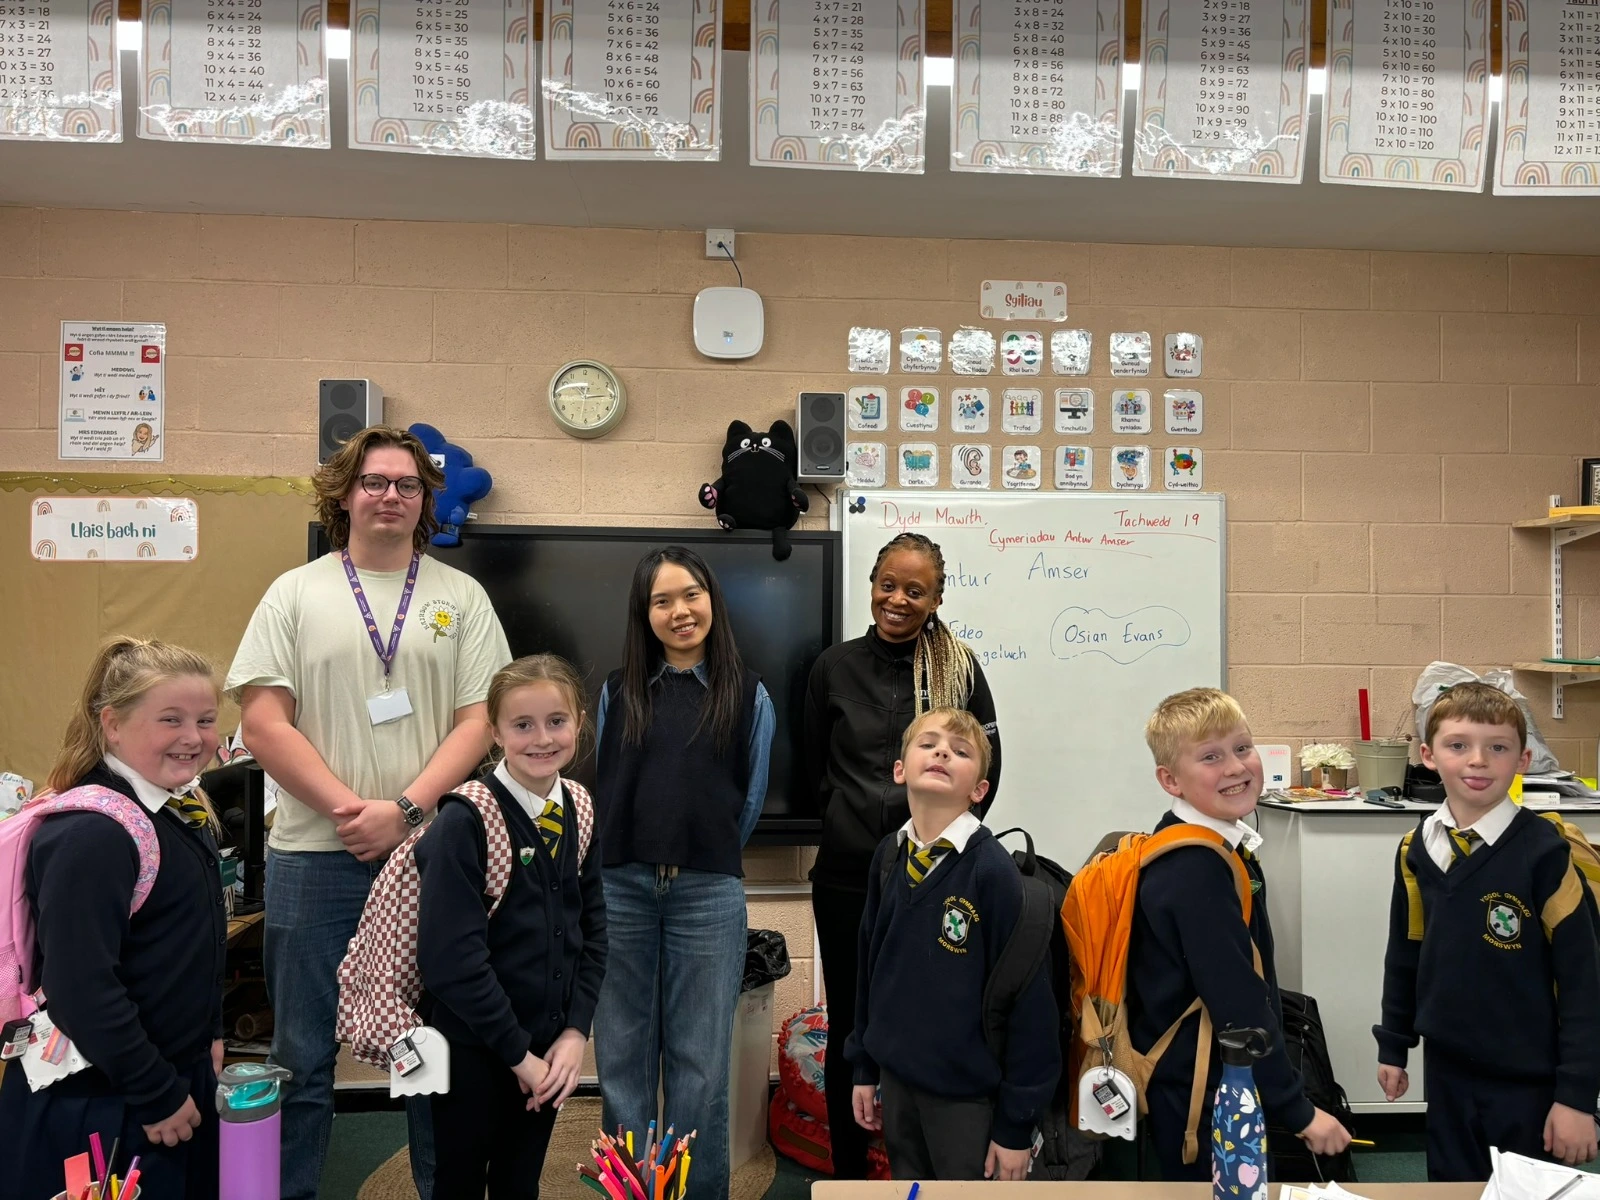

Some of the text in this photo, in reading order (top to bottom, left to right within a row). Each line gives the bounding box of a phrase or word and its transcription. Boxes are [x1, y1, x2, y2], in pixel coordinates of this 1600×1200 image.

[207, 51, 214, 60] 9
[227, 52, 235, 60] 4
[248, 52, 261, 62] 36
[415, 48, 422, 57] 8
[434, 49, 441, 58] 5
[454, 50, 469, 60] 40
[606, 65, 614, 74] 9
[625, 66, 632, 75] 6
[644, 67, 658, 76] 54
[813, 68, 820, 77] 8
[832, 68, 838, 77] 7
[851, 69, 864, 78] 56
[1200, 77, 1207, 86] 8
[1218, 78, 1225, 87] 9
[1236, 79, 1249, 88] 72
[1014, 86, 1020, 95] 9
[1032, 86, 1039, 95] 8
[1050, 87, 1063, 96] 72
[1381, 99, 1388, 108] 9
[1399, 100, 1409, 109] 10
[1420, 102, 1434, 111] 90
[883, 501, 921, 531] Dydd
[1114, 510, 1200, 528] Tachwedd 19
[71, 522, 156, 538] Llais bach ni
[988, 531, 1135, 551] Cymeriadau Antur Amser
[945, 551, 1090, 588] ntur Amser
[1064, 623, 1164, 643] Osian Evans
[976, 646, 1028, 667] gelwch
[1482, 933, 1522, 949] MORSWYN
